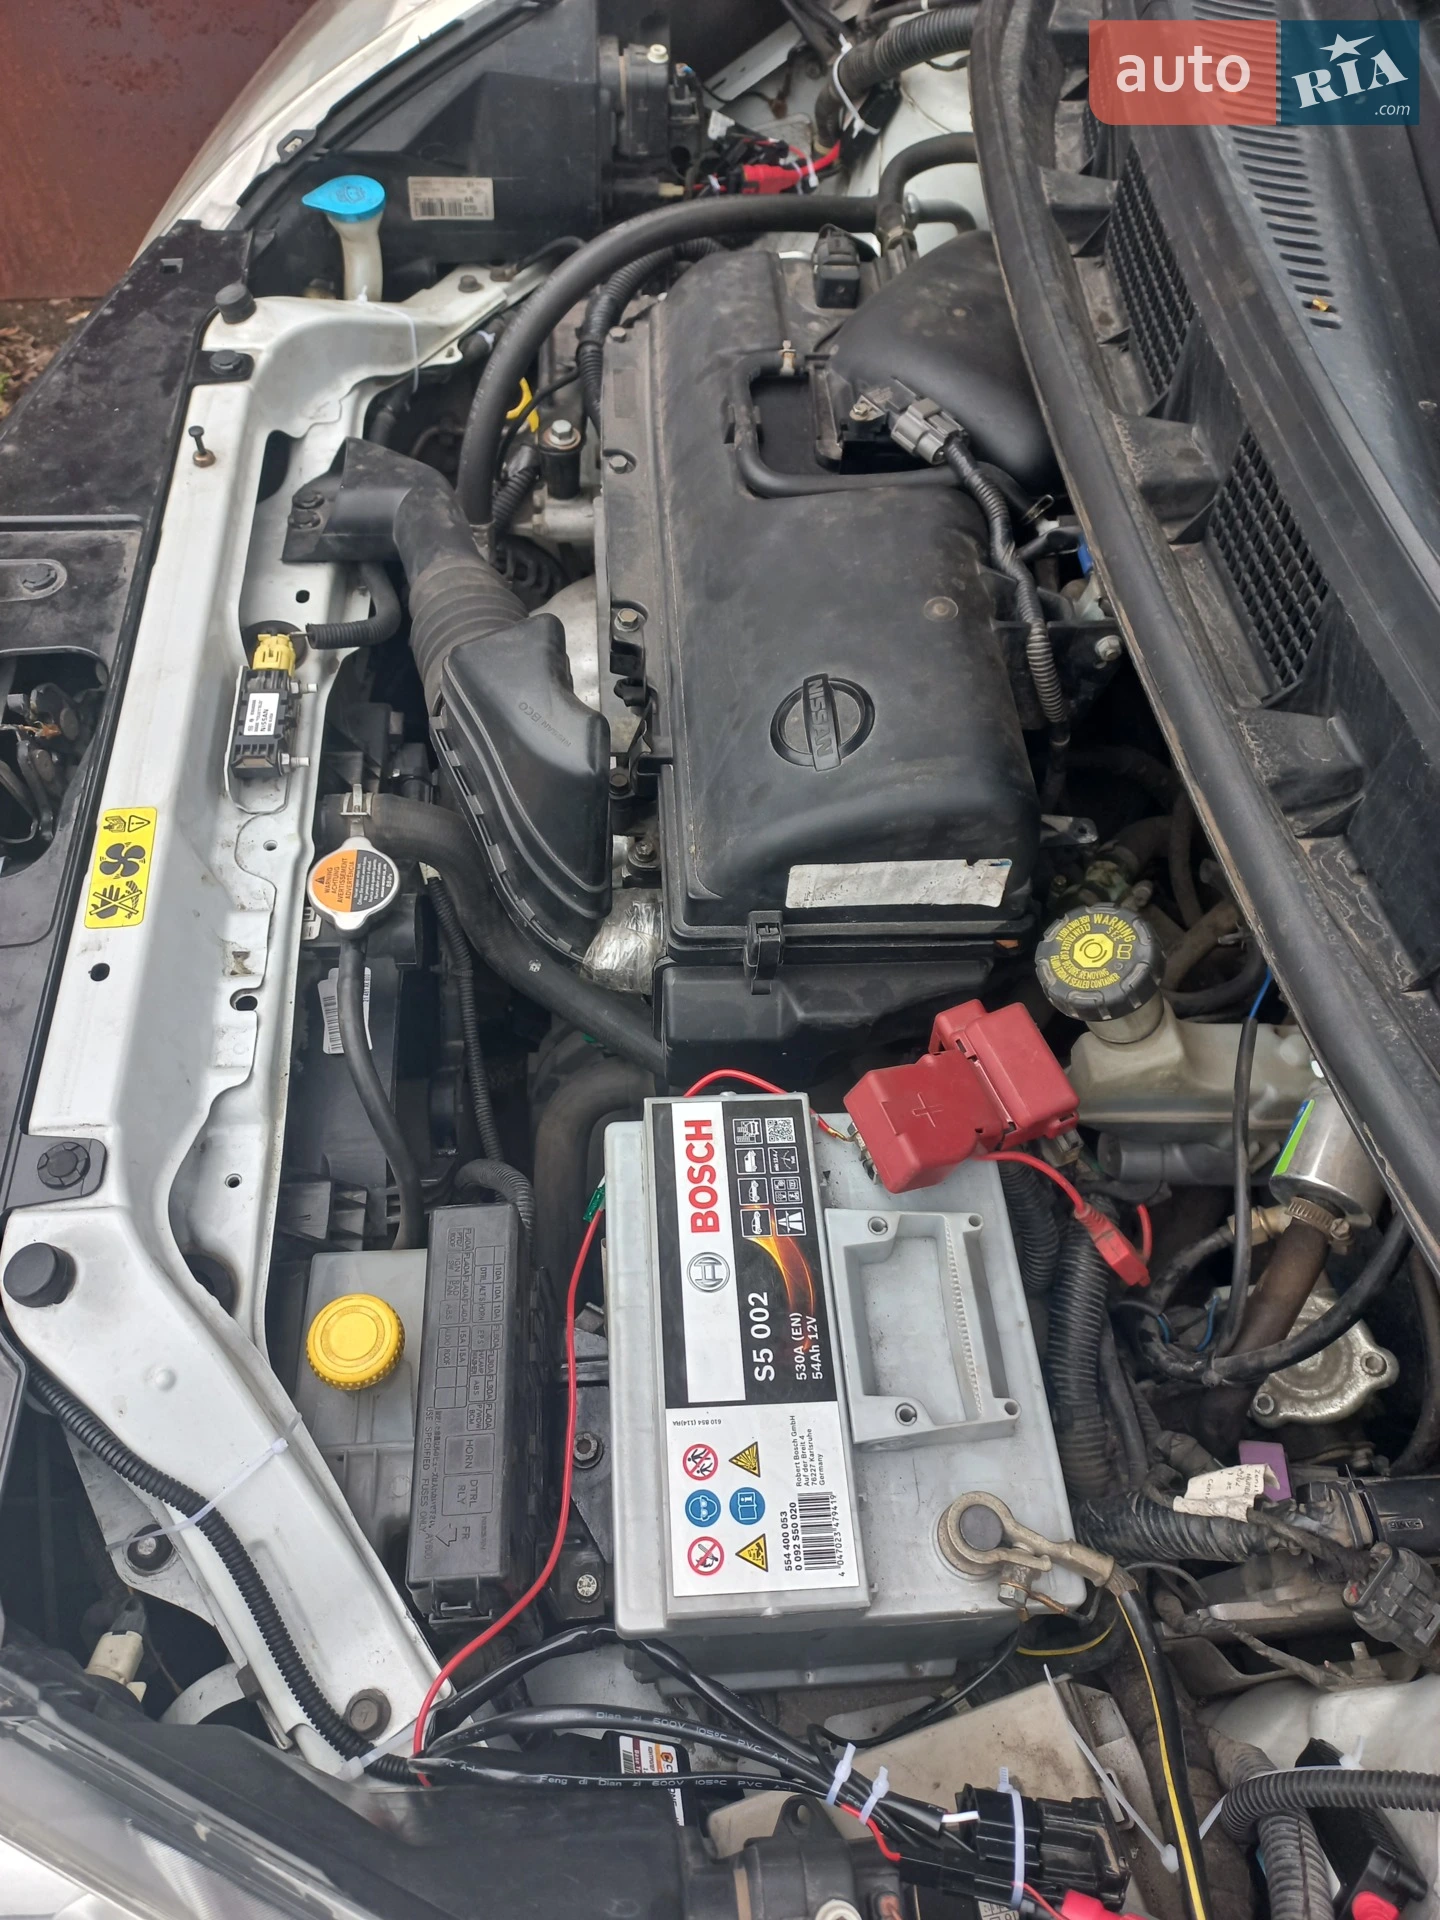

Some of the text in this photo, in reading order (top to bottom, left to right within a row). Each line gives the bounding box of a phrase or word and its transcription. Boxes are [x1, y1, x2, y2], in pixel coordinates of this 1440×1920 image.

[260, 709, 269, 732] NISSAN
[808, 679, 833, 757] NISSAN
[541, 720, 572, 748] NISSAN
[324, 867, 333, 894] WARNING
[331, 867, 340, 894] ACHTUNG
[337, 858, 347, 903] AVERTISSEMENT
[1094, 914, 1136, 942] WARNING
[1106, 926, 1121, 941] SEE
[1079, 968, 1110, 979] REMOVING
[684, 1120, 720, 1233] BOSCH
[478, 1304, 486, 1321] HORN
[747, 1292, 775, 1382] S5 002
[790, 1313, 807, 1380] 530A (EN)
[806, 1315, 824, 1380] 54Ah 12V
[459, 1349, 467, 1363] 15A
[423, 1426, 432, 1470] SPECIFIED
[465, 1439, 474, 1469] HORN
[789, 1415, 802, 1486] Robert Bosch GmbH
[799, 1441, 807, 1458] Breit
[806, 1428, 815, 1462] Karlsruhe
[801, 1460, 809, 1472] der
[802, 1474, 810, 1486] Auf
[817, 1454, 826, 1485] Germany
[420, 1478, 430, 1506] FUSES
[457, 1485, 466, 1504] RLY
[469, 1480, 478, 1508] DTRL
[789, 1502, 798, 1520] 020
[830, 1495, 839, 1527] 479419
[461, 1526, 470, 1540] FR
[780, 1511, 792, 1571] 554 400 053
[791, 1523, 800, 1541] S50
[793, 1544, 801, 1562] 092
[833, 1532, 844, 1565] 047023
[596, 1712, 621, 1720] Dian
[653, 1718, 686, 1729] 600V
[737, 1739, 761, 1753] PVC
[540, 1776, 568, 1785] Feng
[579, 1777, 587, 1785] di
[598, 1779, 622, 1787] Dian
